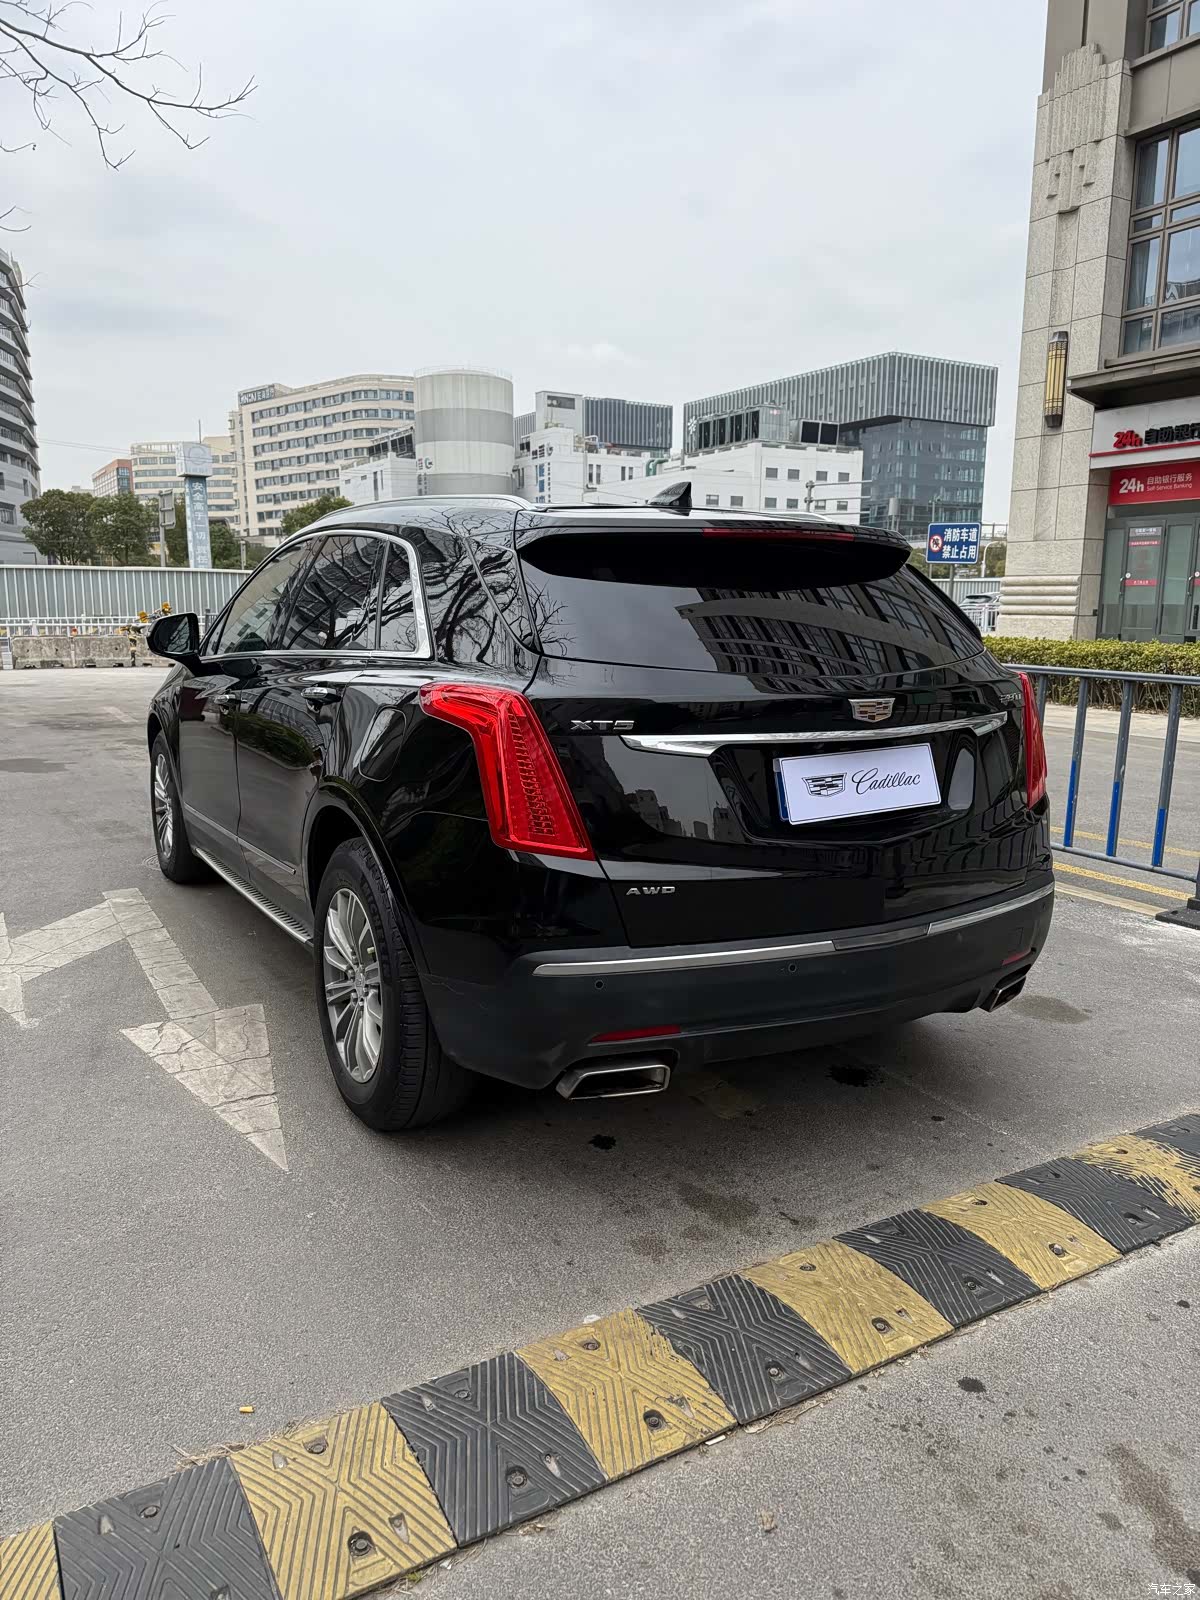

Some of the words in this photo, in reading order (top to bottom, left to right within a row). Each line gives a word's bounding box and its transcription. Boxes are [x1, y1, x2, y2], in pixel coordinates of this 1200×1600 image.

[1113, 430, 1143, 449] 24h
[1119, 478, 1145, 494] 24h
[1147, 473, 1193, 485] 自助银行服务
[192, 482, 206, 540] 安全高于一切
[943, 527, 978, 542] 消防车道
[942, 544, 977, 559] 禁止占用
[570, 720, 635, 730] XT5
[851, 767, 921, 795] Cadillac
[625, 886, 675, 895] AWD
